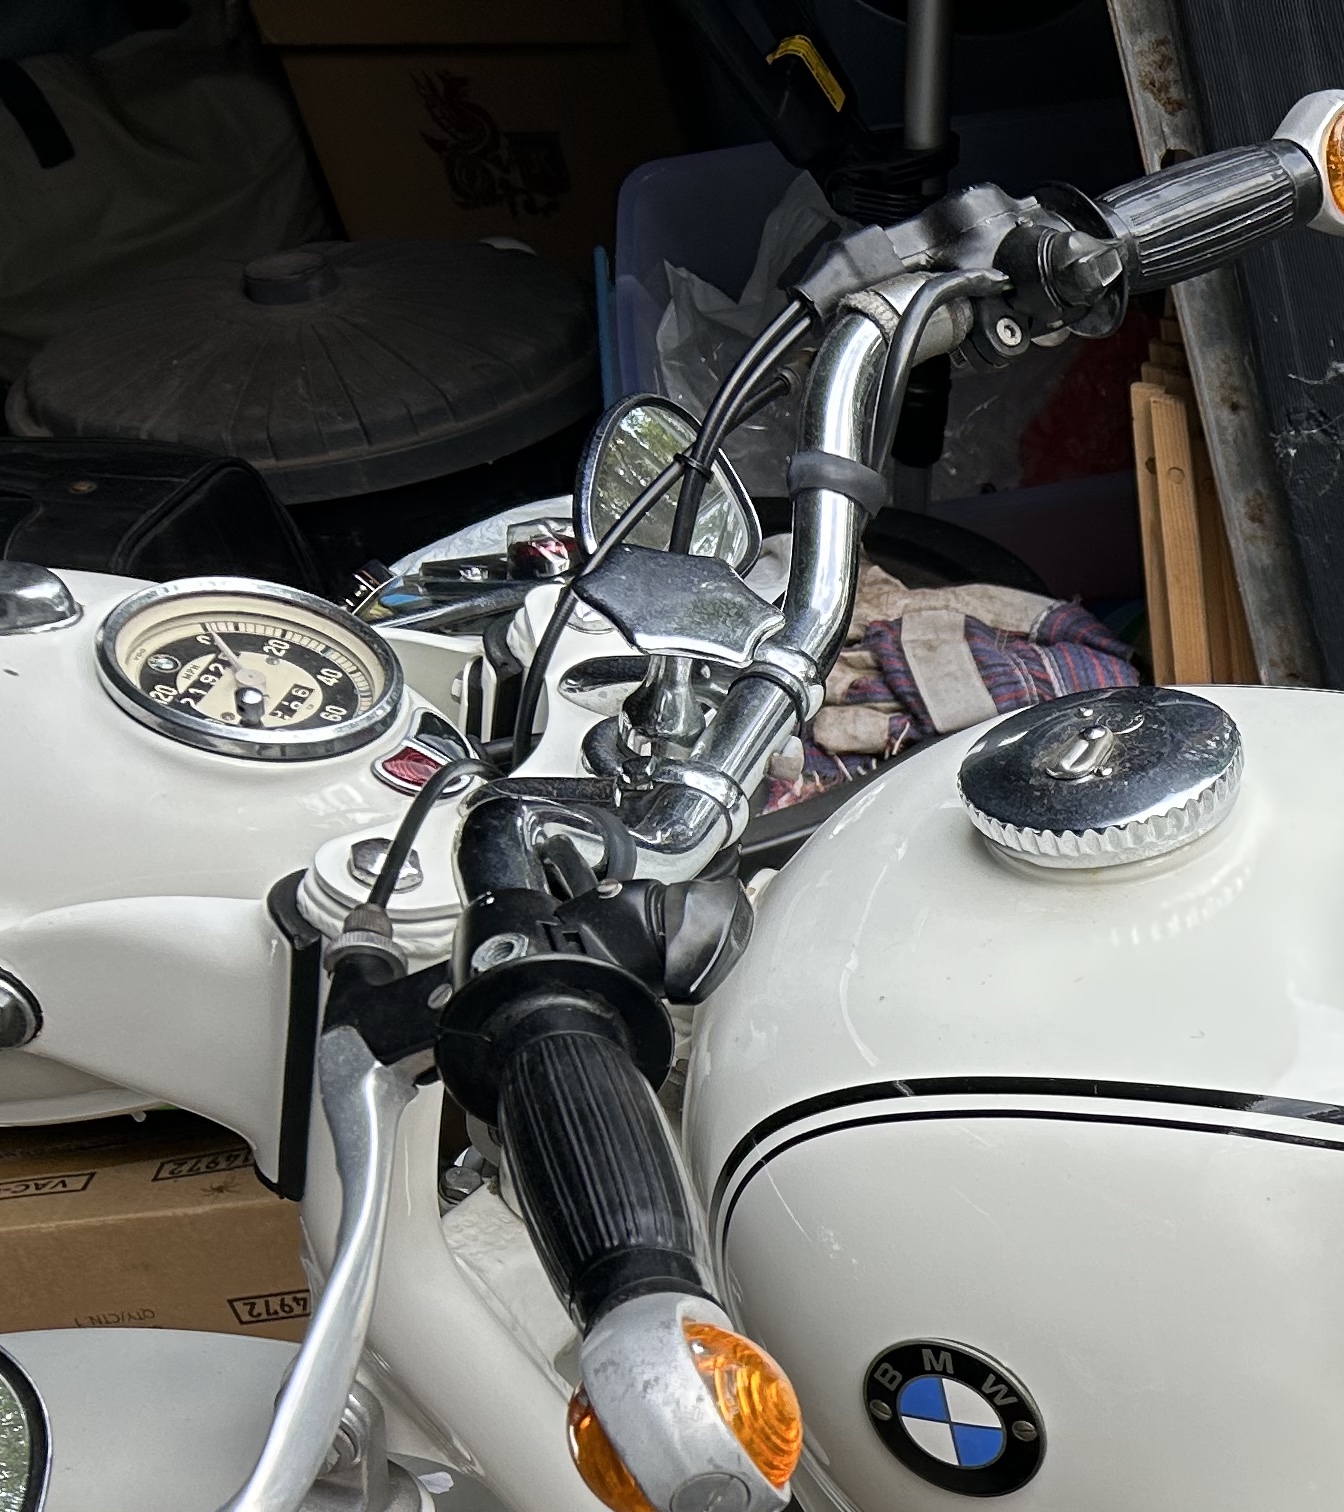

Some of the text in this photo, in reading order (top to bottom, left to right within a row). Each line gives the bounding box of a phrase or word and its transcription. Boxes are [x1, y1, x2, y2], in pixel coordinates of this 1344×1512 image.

[263, 639, 290, 657] 20
[180, 652, 230, 708] 2192
[182, 663, 200, 681] MPH
[317, 668, 343, 687] 40
[320, 705, 348, 722] 60
[0, 1179, 68, 1194] VAC-
[242, 1296, 308, 1319] 4972
[873, 1348, 1019, 1406] BMW
